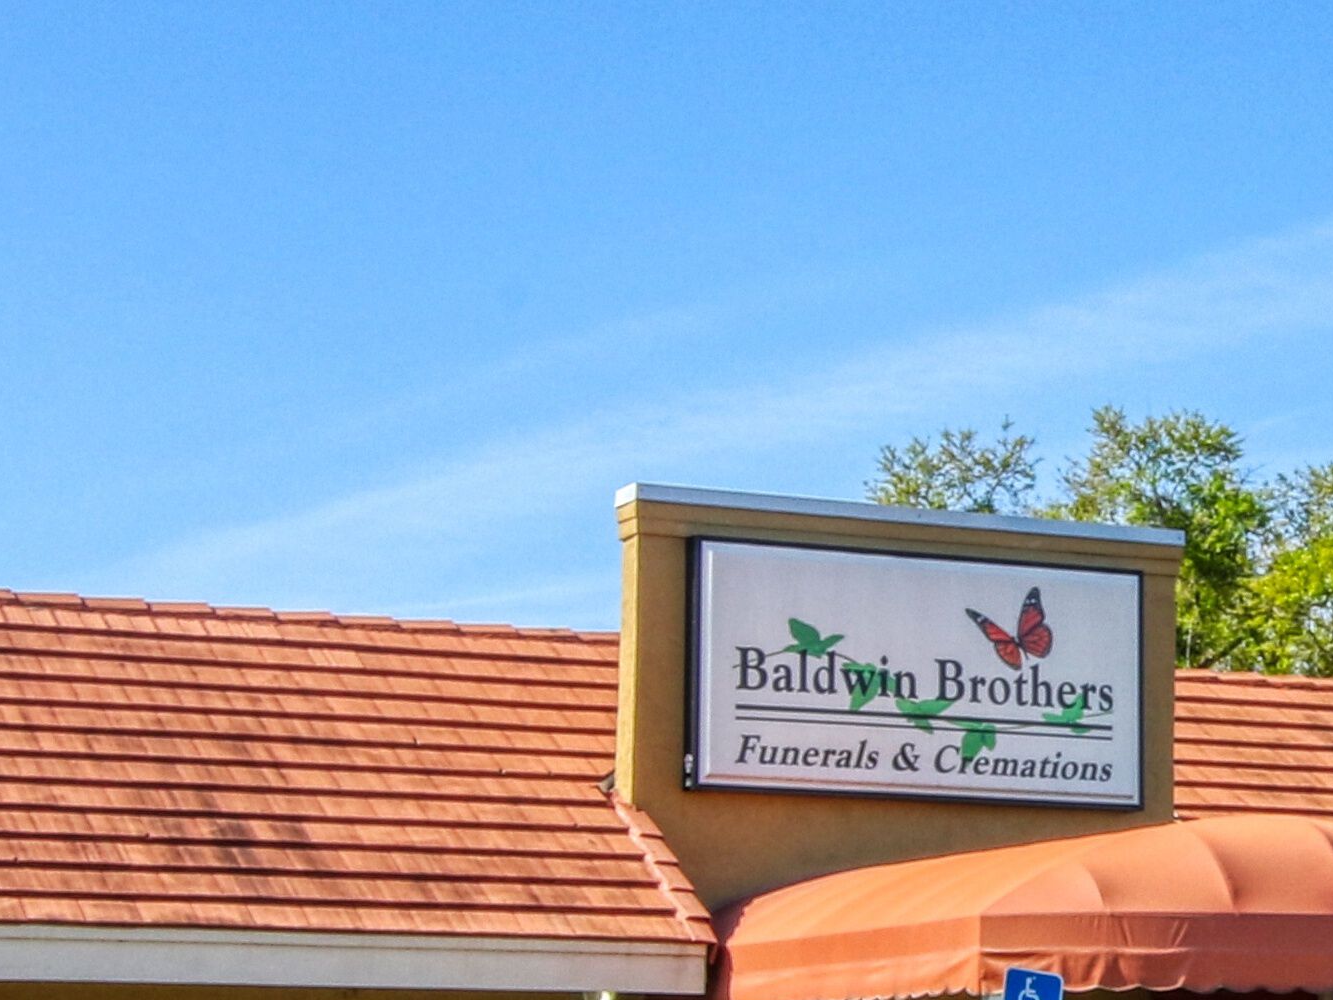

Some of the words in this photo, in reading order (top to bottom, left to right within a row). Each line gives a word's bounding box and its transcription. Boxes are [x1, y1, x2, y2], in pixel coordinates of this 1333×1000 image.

[735, 646, 916, 699] Baldwin
[935, 658, 1114, 712] Brothers
[735, 734, 879, 771] Funerals
[892, 742, 920, 773] &
[934, 744, 1113, 783] Cremations
